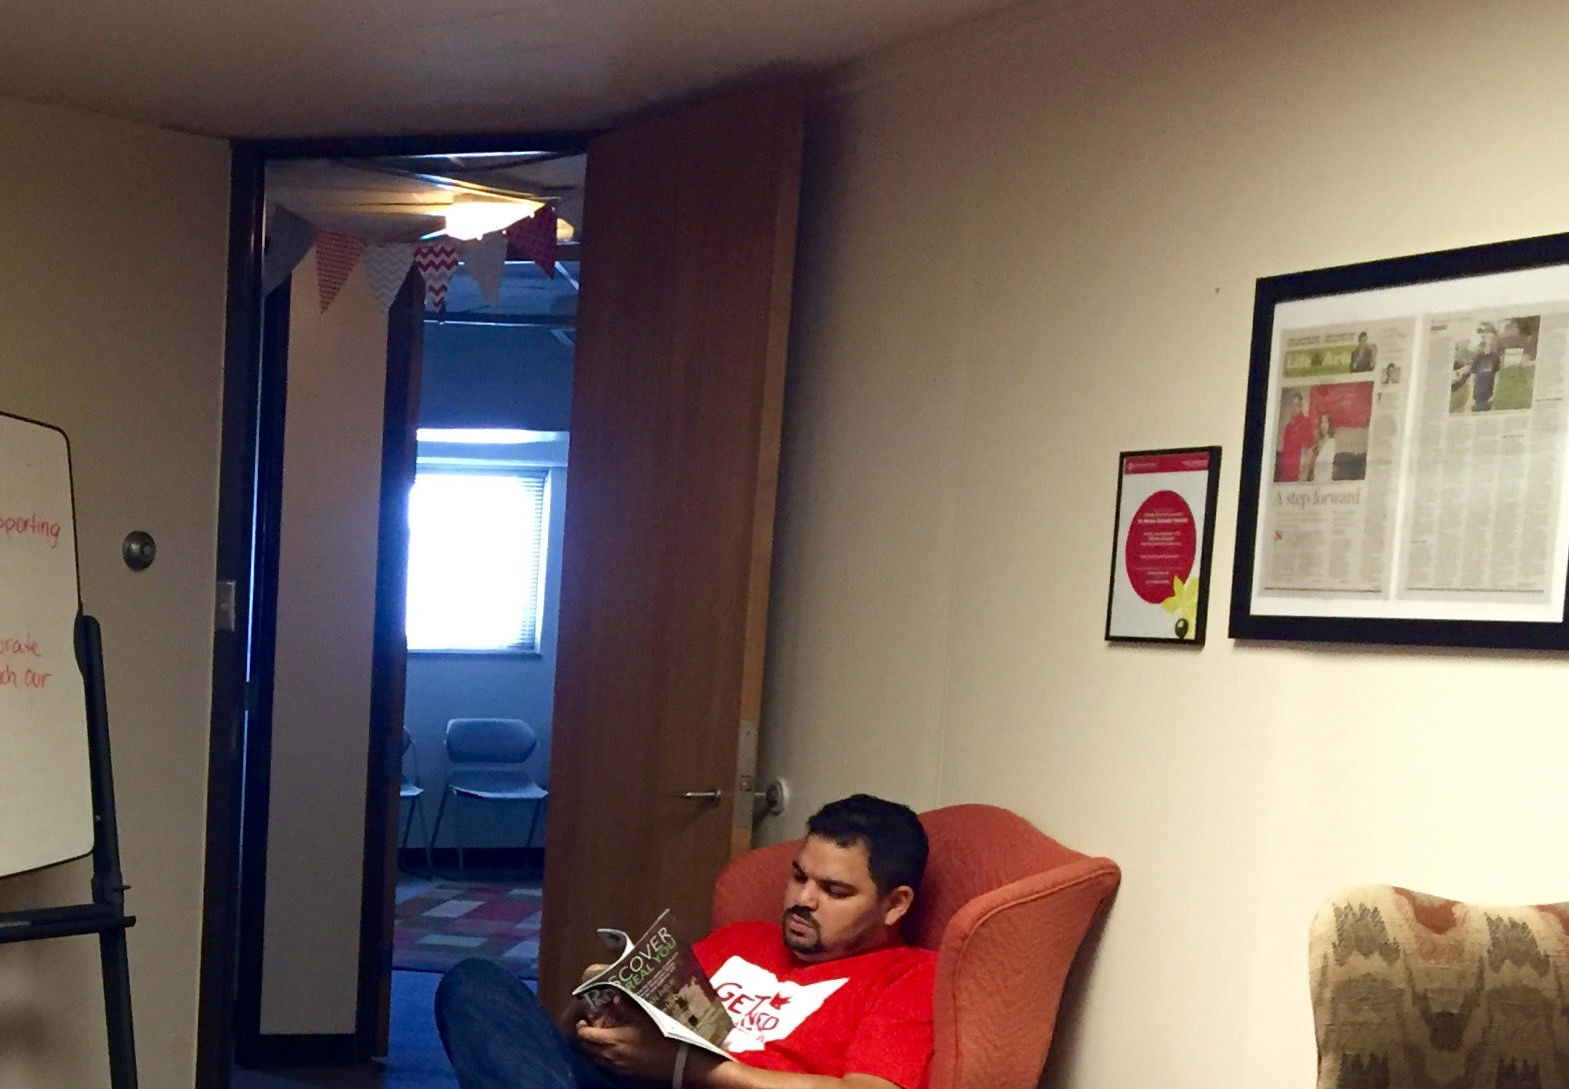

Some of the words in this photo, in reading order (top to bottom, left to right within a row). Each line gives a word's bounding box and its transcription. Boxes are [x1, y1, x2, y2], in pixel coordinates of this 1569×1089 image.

[24, 667, 52, 689] our
[608, 926, 673, 986] SCOVER
[653, 937, 678, 964] YOU
